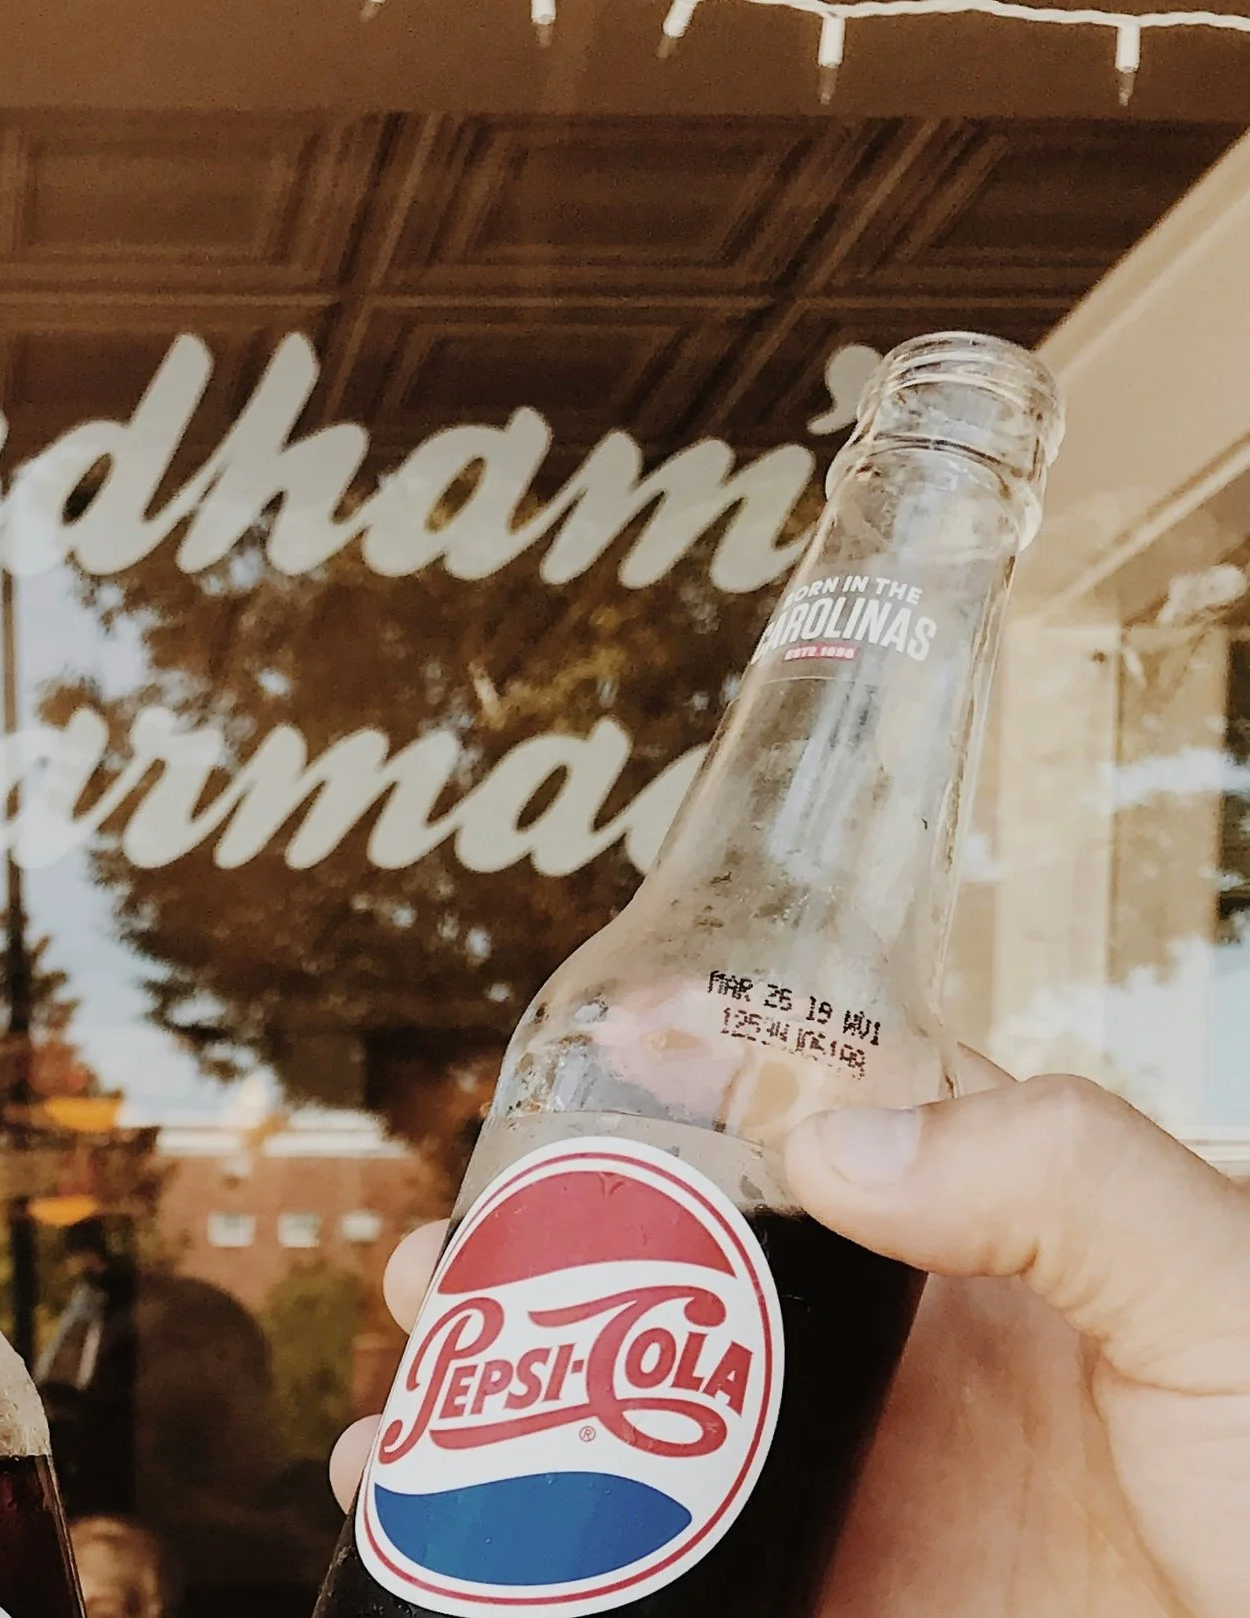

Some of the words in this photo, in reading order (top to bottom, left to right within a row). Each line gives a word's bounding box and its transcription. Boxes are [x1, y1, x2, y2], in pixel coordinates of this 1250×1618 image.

[842, 575, 869, 593] IN
[875, 577, 923, 606] THE
[751, 597, 937, 664] CAROLINAS
[708, 970, 753, 1001] MAR
[379, 1286, 754, 1465] PEPSI-COLA
